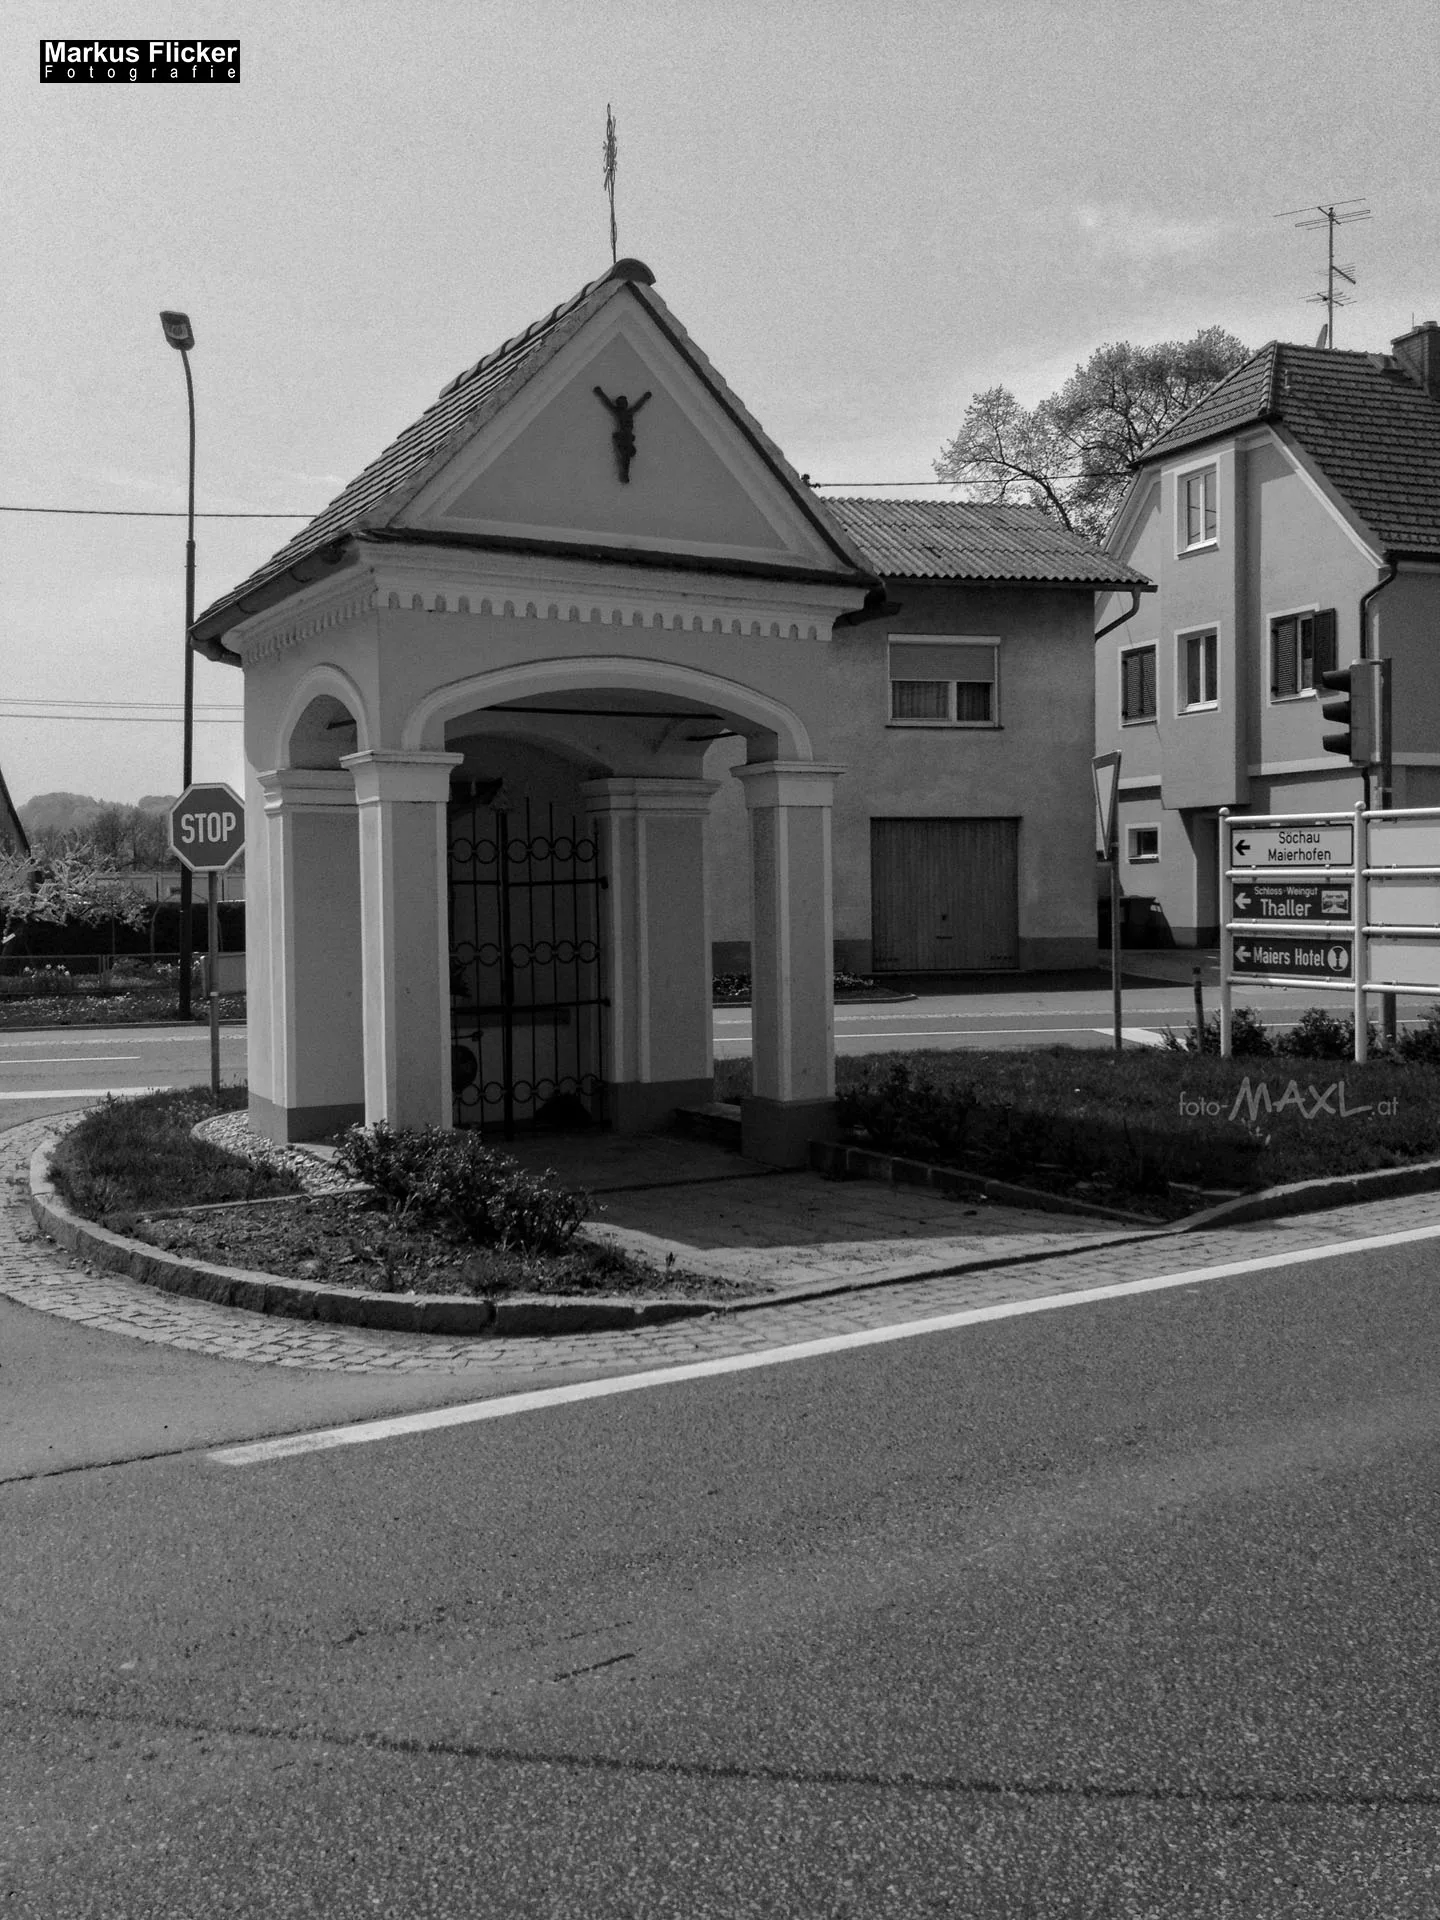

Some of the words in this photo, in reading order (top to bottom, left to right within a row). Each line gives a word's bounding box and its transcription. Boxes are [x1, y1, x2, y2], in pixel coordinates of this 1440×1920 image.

[181, 812, 236, 844] STOP
[1278, 831, 1321, 844] Söchau
[1268, 848, 1331, 861] Maierhofen
[1260, 898, 1312, 916] Thaller
[1253, 946, 1291, 965] Maiers
[1294, 947, 1325, 966] Hotel
